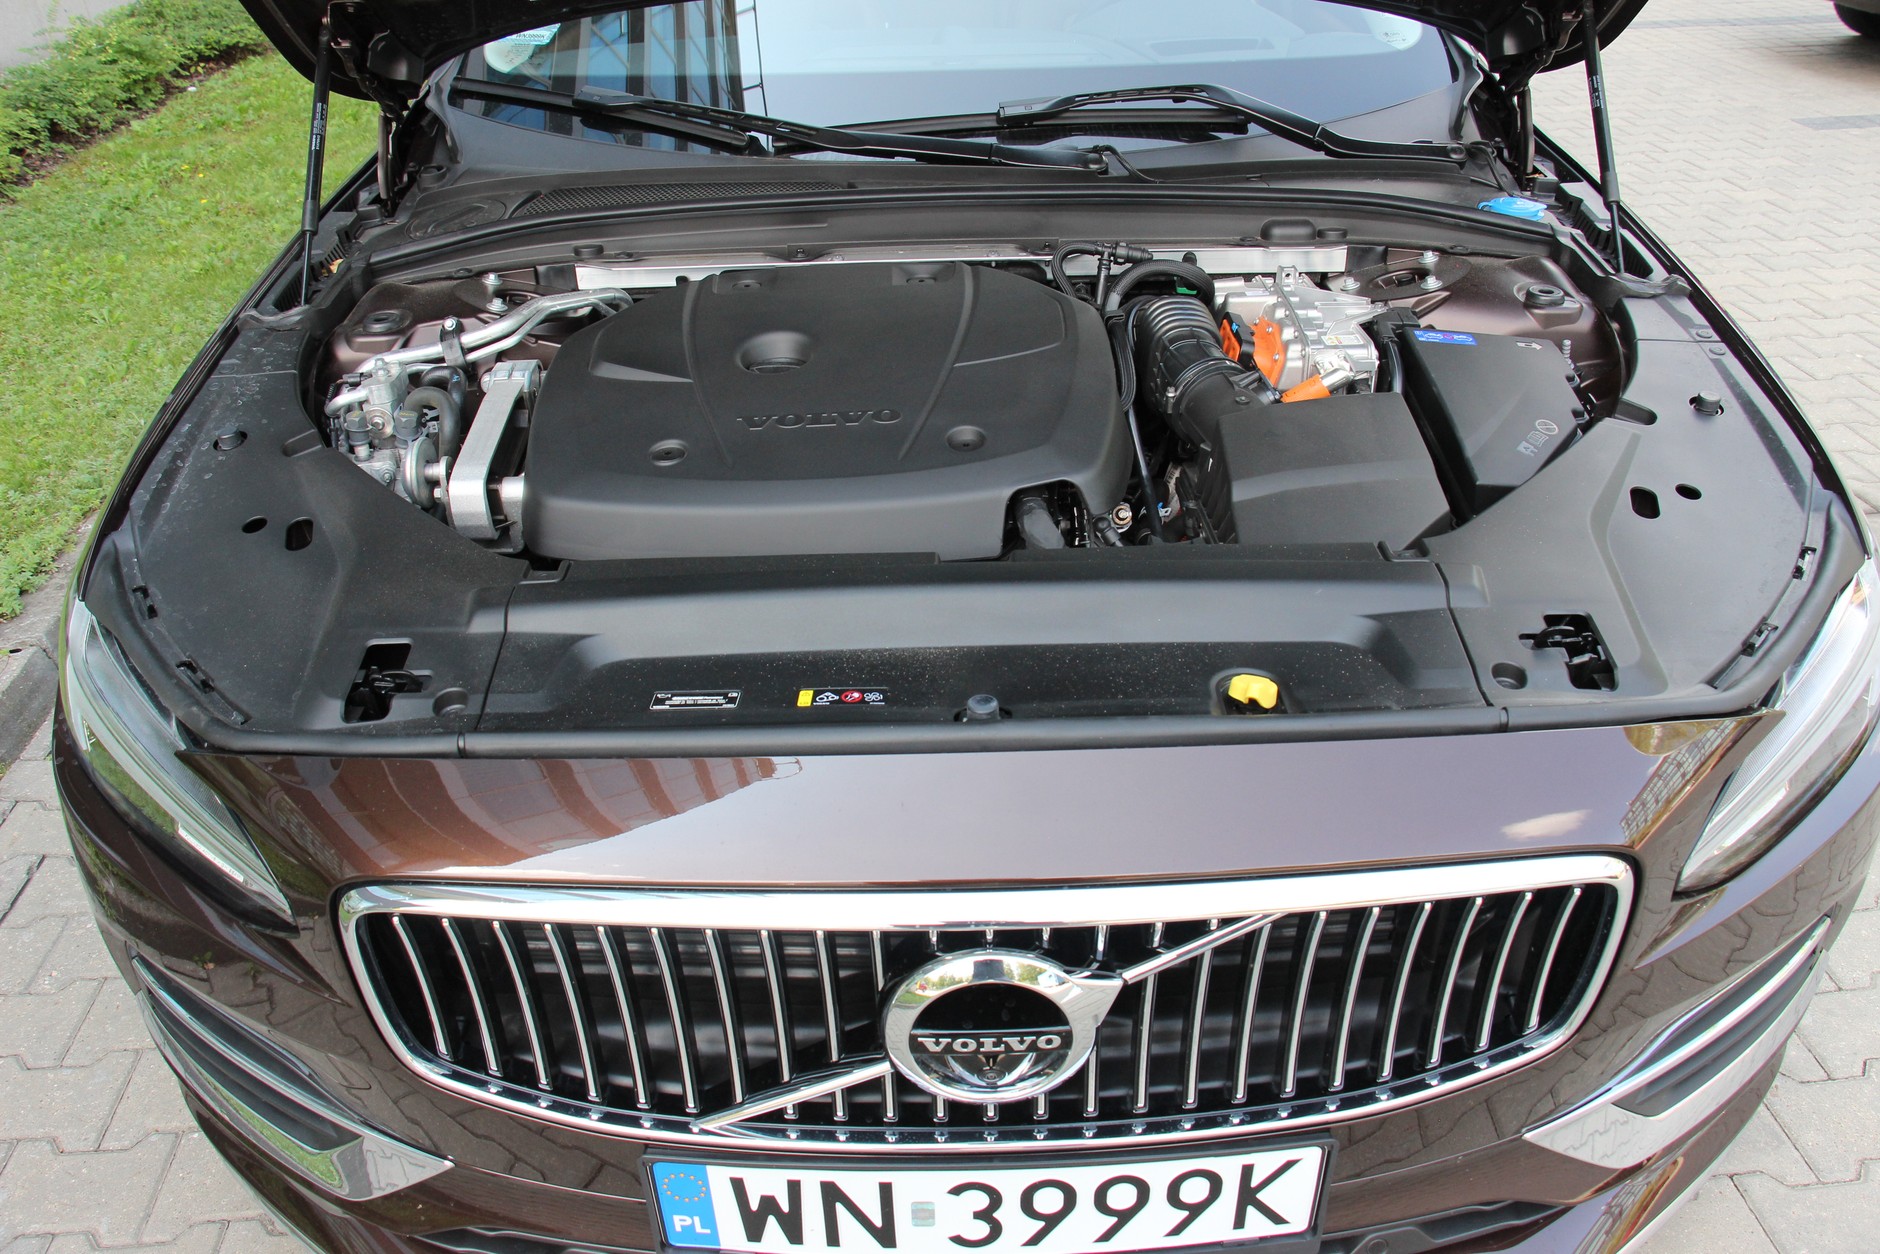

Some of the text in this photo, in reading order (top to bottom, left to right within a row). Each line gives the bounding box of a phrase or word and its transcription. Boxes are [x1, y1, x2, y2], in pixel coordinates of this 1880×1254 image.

[736, 408, 902, 431] VOLVO
[917, 1035, 1062, 1053] VOLVO
[729, 1158, 1304, 1249] WN 3999K
[672, 1214, 711, 1234] PL
